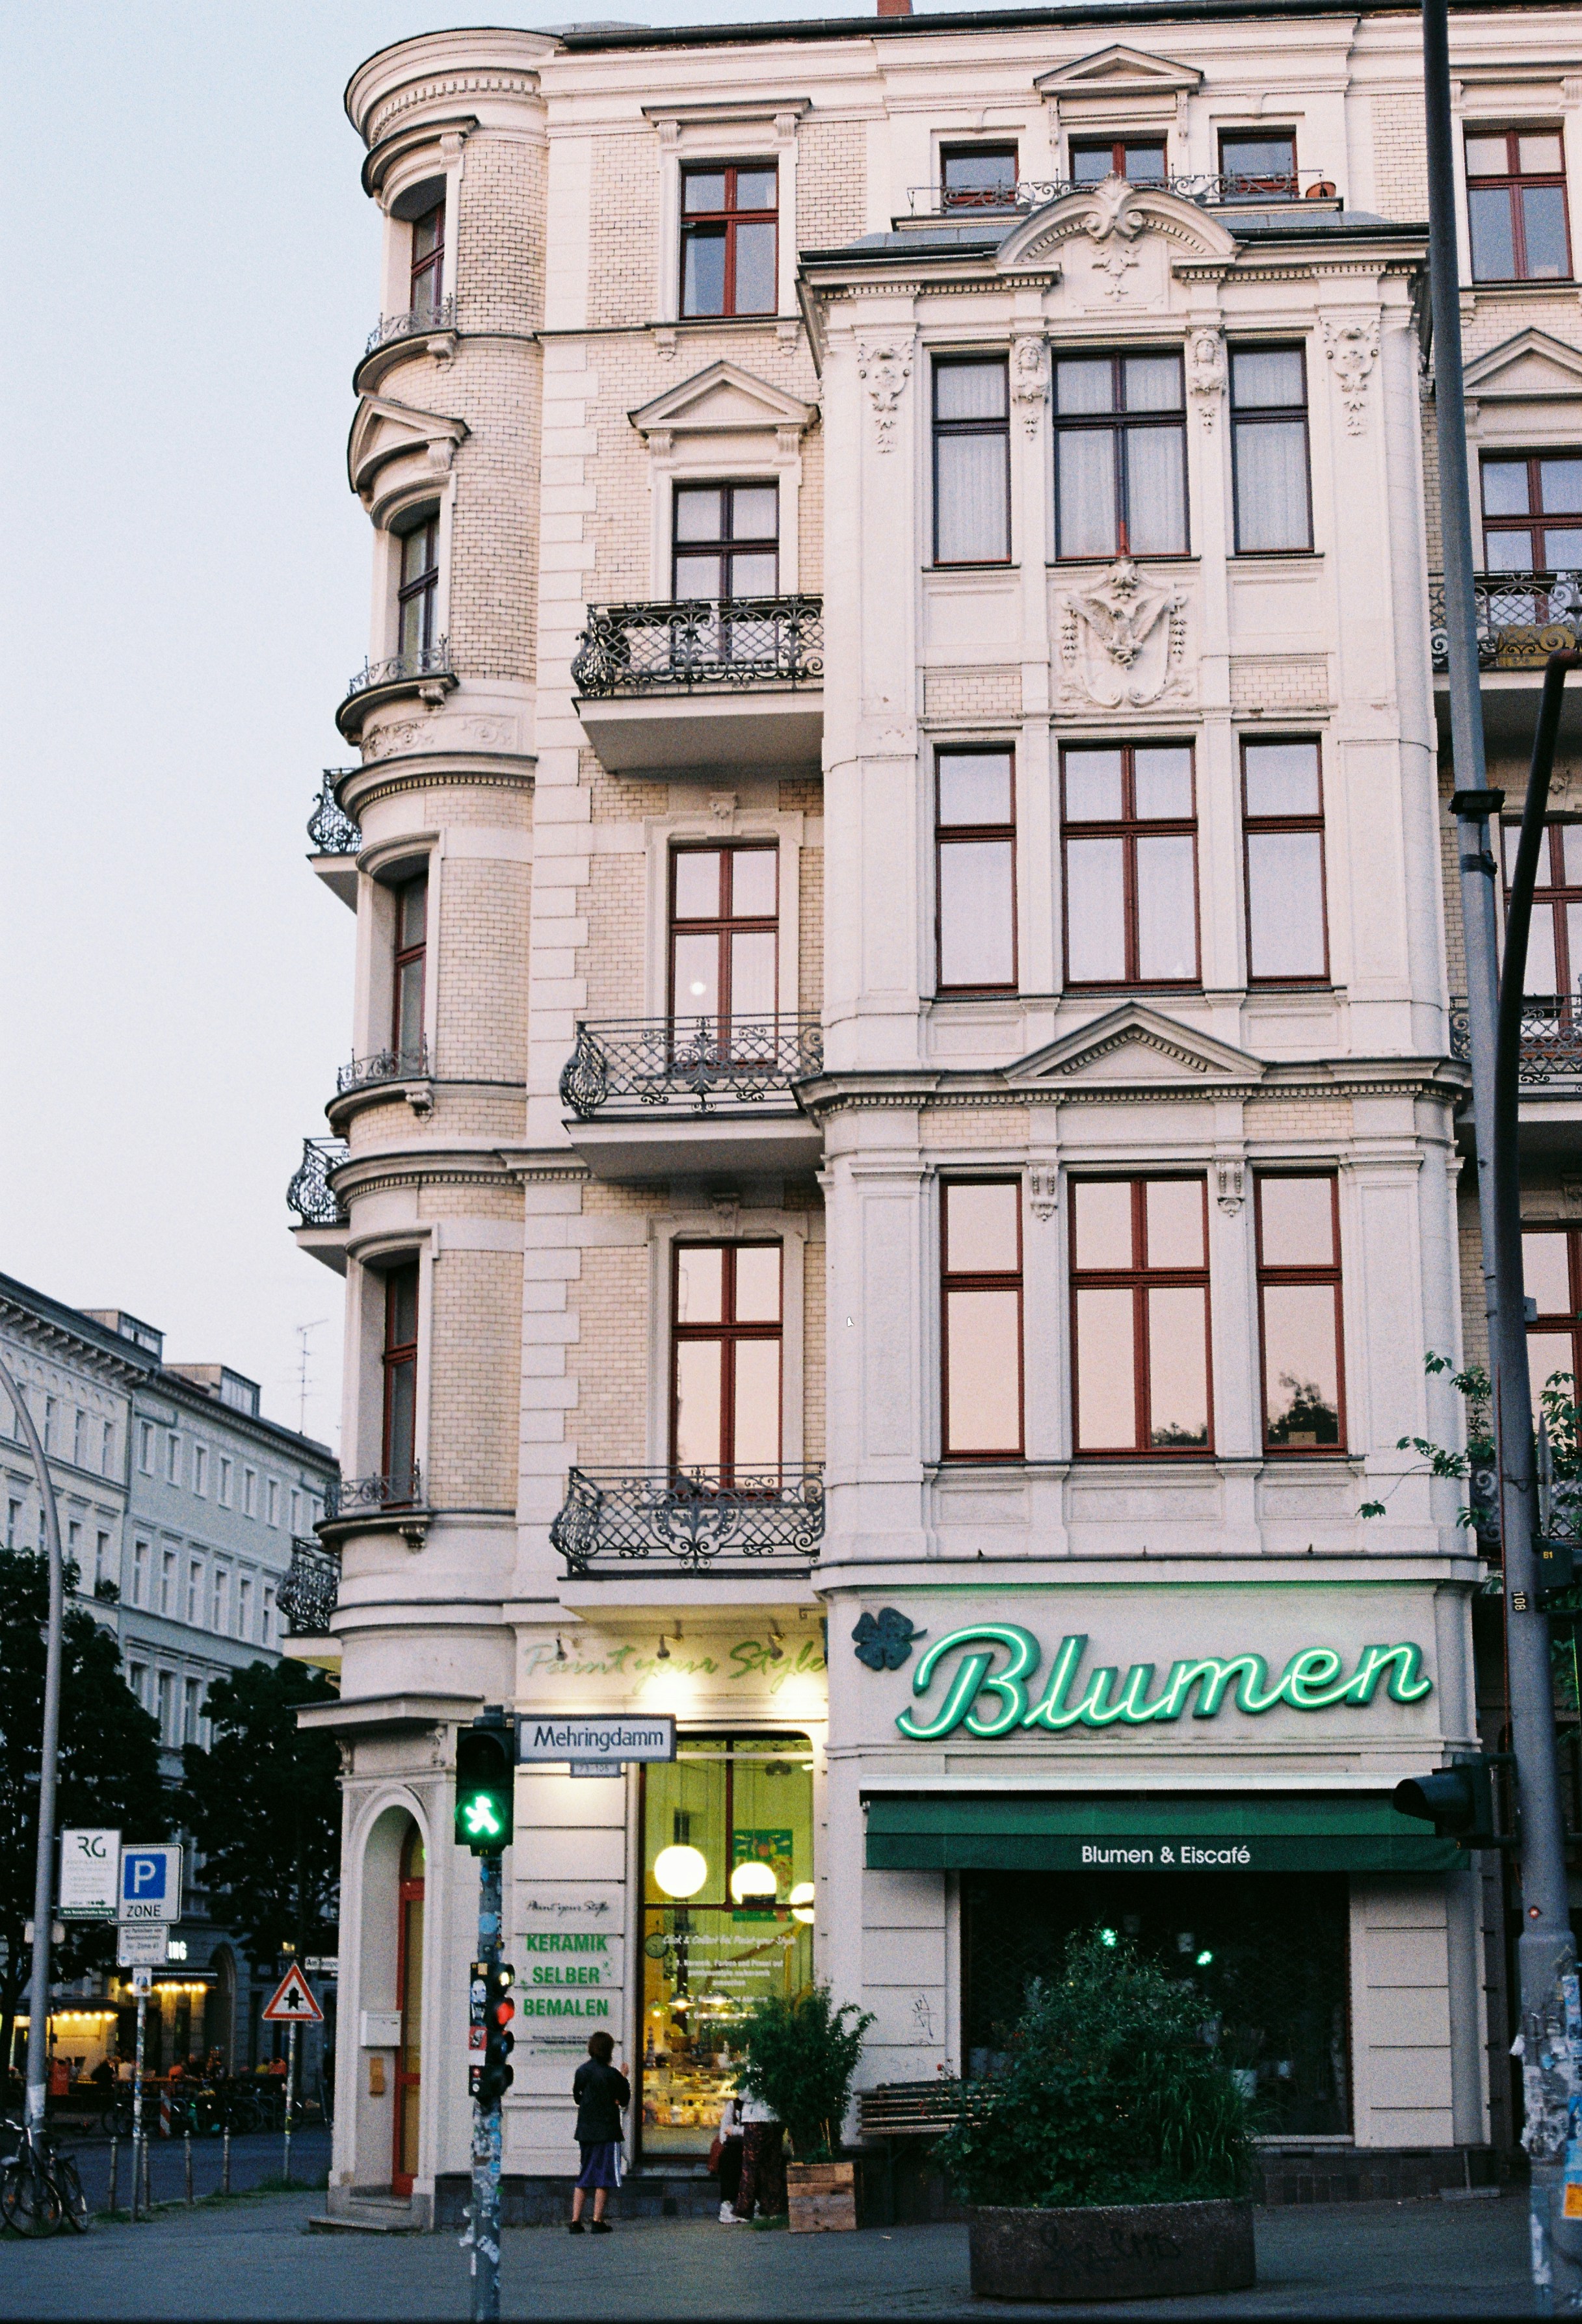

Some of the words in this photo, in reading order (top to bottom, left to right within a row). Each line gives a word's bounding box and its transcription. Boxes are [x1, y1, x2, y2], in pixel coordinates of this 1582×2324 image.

[1513, 1591, 1526, 1611] 108
[524, 1641, 636, 1676] Paint
[633, 1656, 719, 1695] your
[728, 1640, 827, 1694] Style
[894, 1622, 1433, 1740] Blumen
[533, 1725, 664, 1752] Mehringdamm
[1081, 1846, 1154, 1863] Blumen
[1160, 1846, 1175, 1863] &
[1181, 1845, 1251, 1864] Eiscafé
[134, 1860, 156, 1893] P
[126, 1905, 161, 1917] ZONE
[527, 1935, 607, 1952] KERAMIK
[533, 1966, 600, 1984] SELBER
[523, 1999, 609, 2016] BEMALEN
